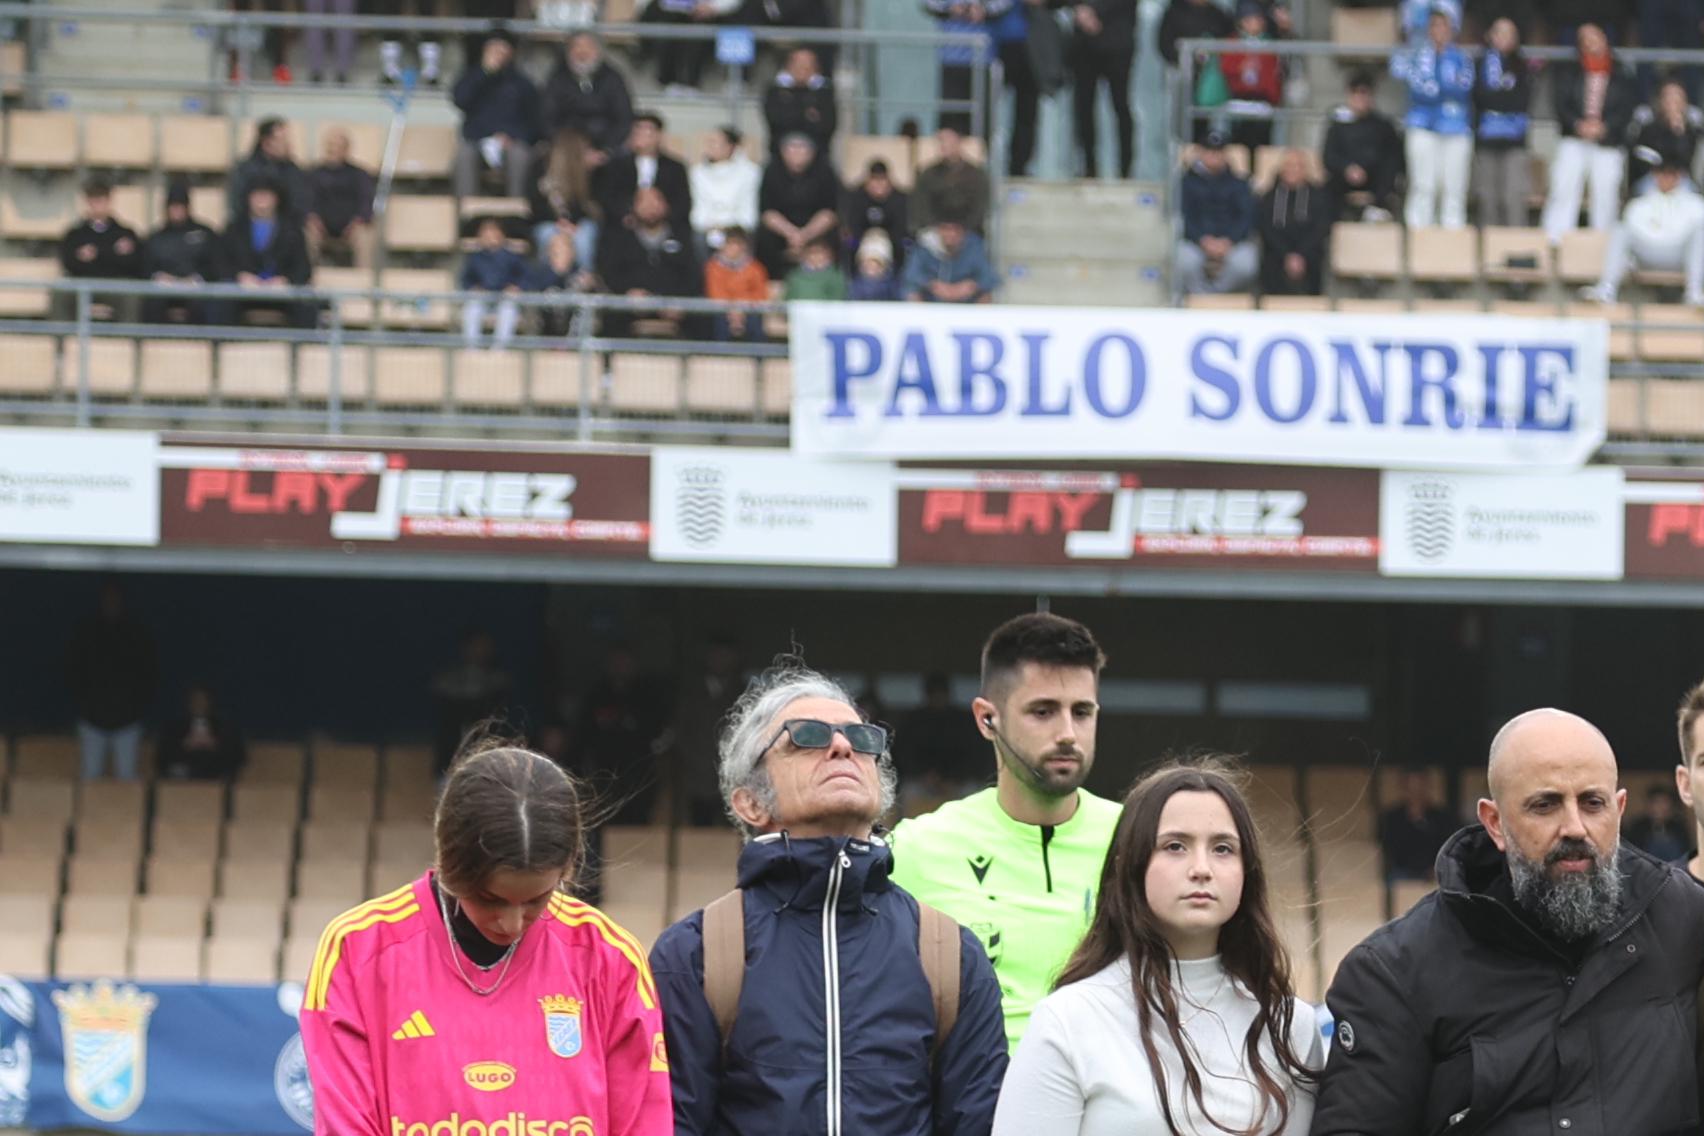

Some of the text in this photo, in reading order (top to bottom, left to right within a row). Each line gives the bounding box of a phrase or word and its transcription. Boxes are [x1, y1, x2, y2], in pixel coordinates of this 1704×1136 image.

[822, 327, 1578, 435] PABLO SONRIE
[466, 1072, 513, 1083] LUGO
